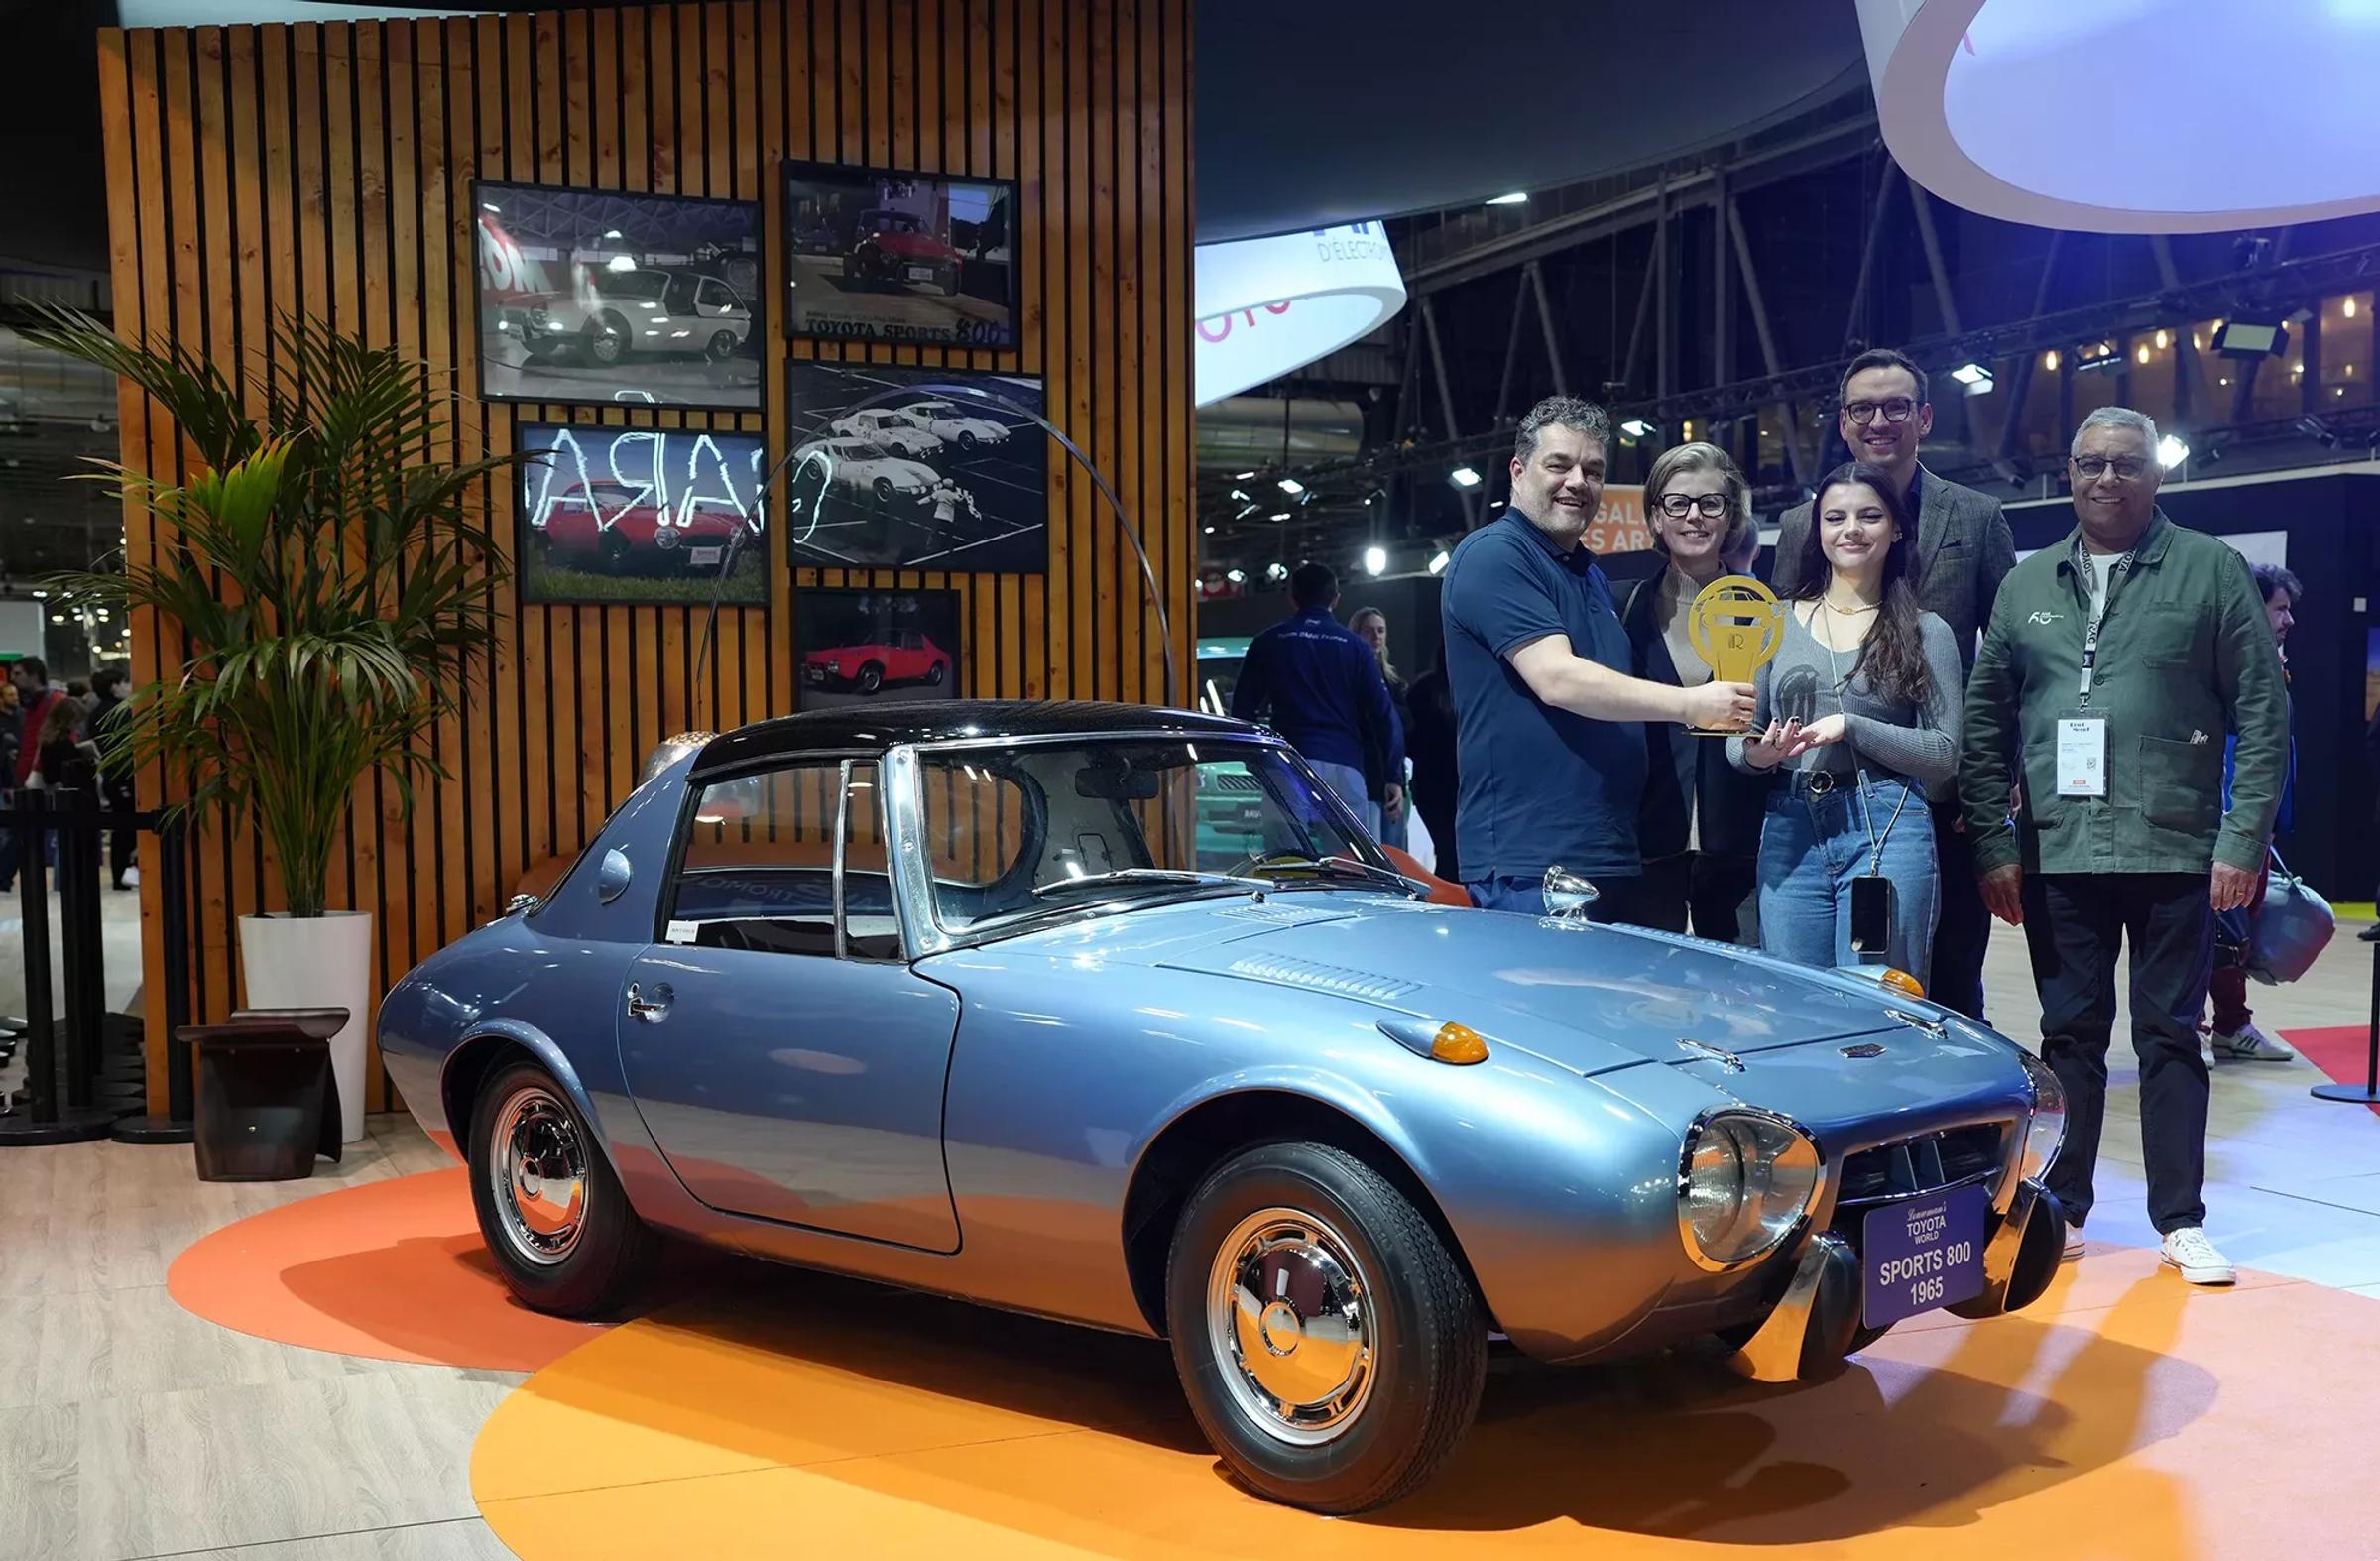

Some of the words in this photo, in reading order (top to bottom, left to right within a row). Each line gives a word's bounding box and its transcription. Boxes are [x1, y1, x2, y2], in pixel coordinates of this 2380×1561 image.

[806, 318, 877, 338] TOYOTA
[883, 324, 951, 341] SPORTS
[955, 318, 1002, 342] 800
[1244, 809, 1262, 819] RAV
[1906, 1215, 1947, 1237] TOYOTA
[1914, 1231, 1939, 1245] WORLD
[1880, 1249, 1943, 1286] SPORTS
[1947, 1241, 1971, 1267] 800
[1910, 1276, 1944, 1305] 1965
